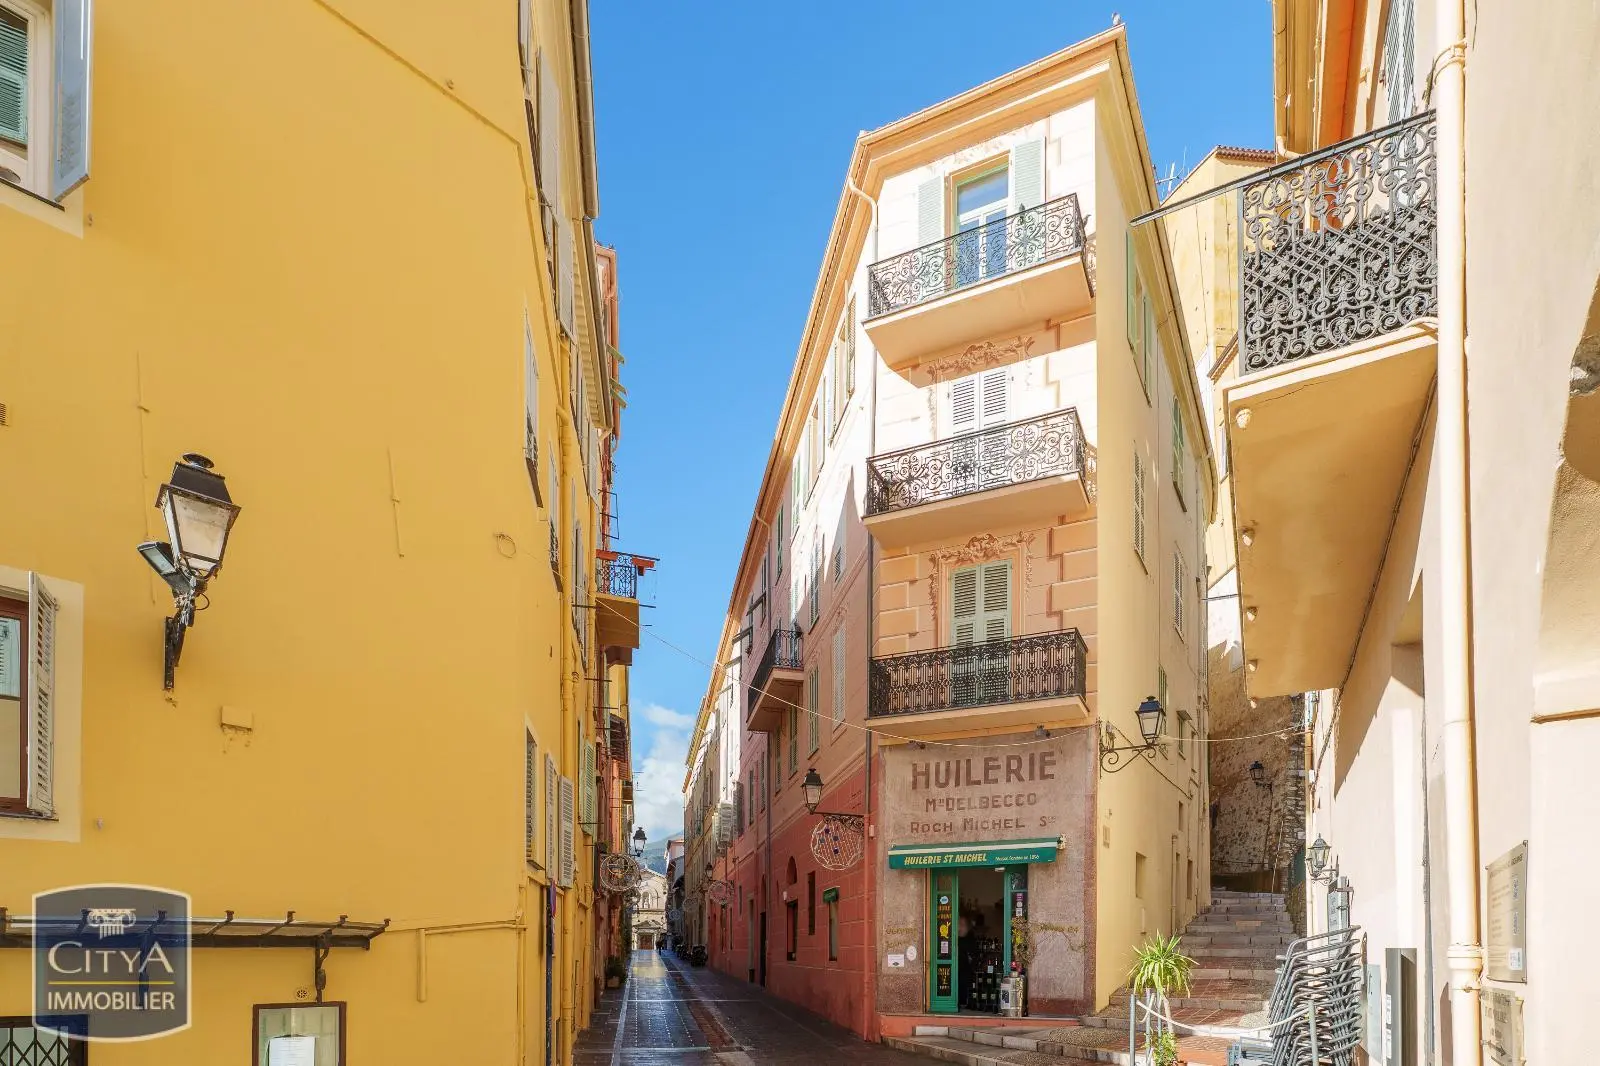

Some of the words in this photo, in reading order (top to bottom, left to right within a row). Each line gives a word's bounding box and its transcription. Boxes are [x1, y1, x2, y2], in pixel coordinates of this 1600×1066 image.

[912, 751, 1056, 790] HUILERIE
[946, 792, 1037, 811] DELBECCO
[910, 821, 953, 833] ROCH
[904, 856, 941, 865] HUILERIE
[955, 853, 987, 863] MICHEL
